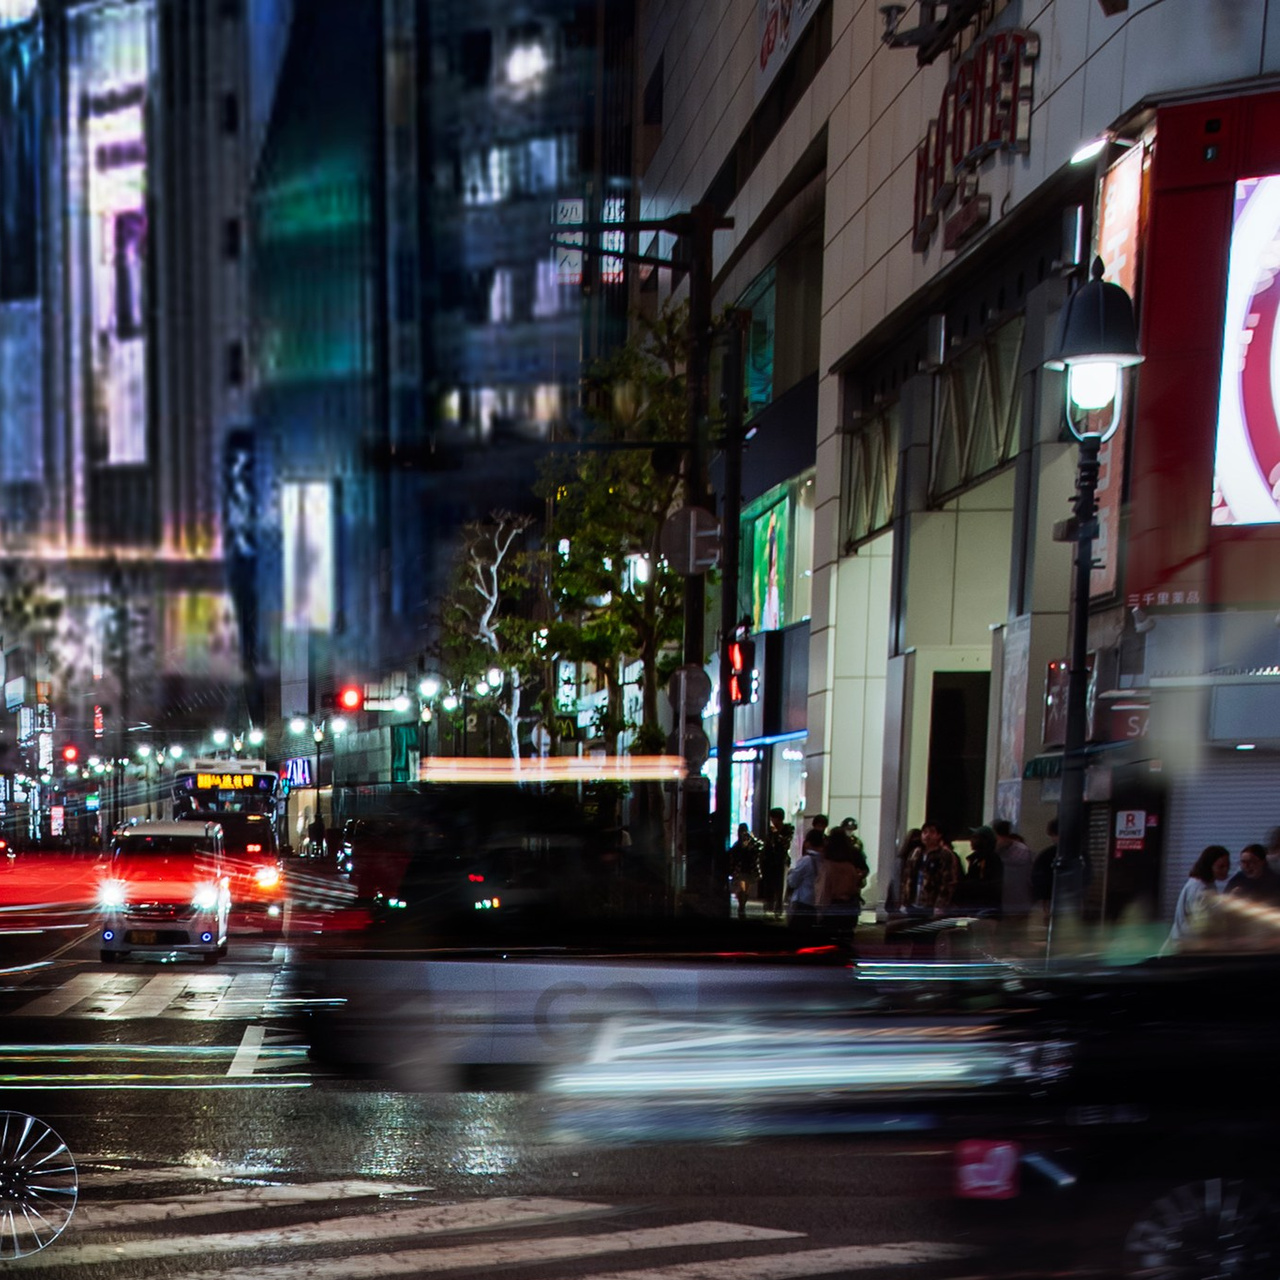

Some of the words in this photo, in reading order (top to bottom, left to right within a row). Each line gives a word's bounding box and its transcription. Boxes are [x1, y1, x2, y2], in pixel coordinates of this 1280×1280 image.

[1128, 591, 1200, 607] 三千里薬品
[286, 758, 311, 785] ZARA
[1125, 813, 1135, 828] R
